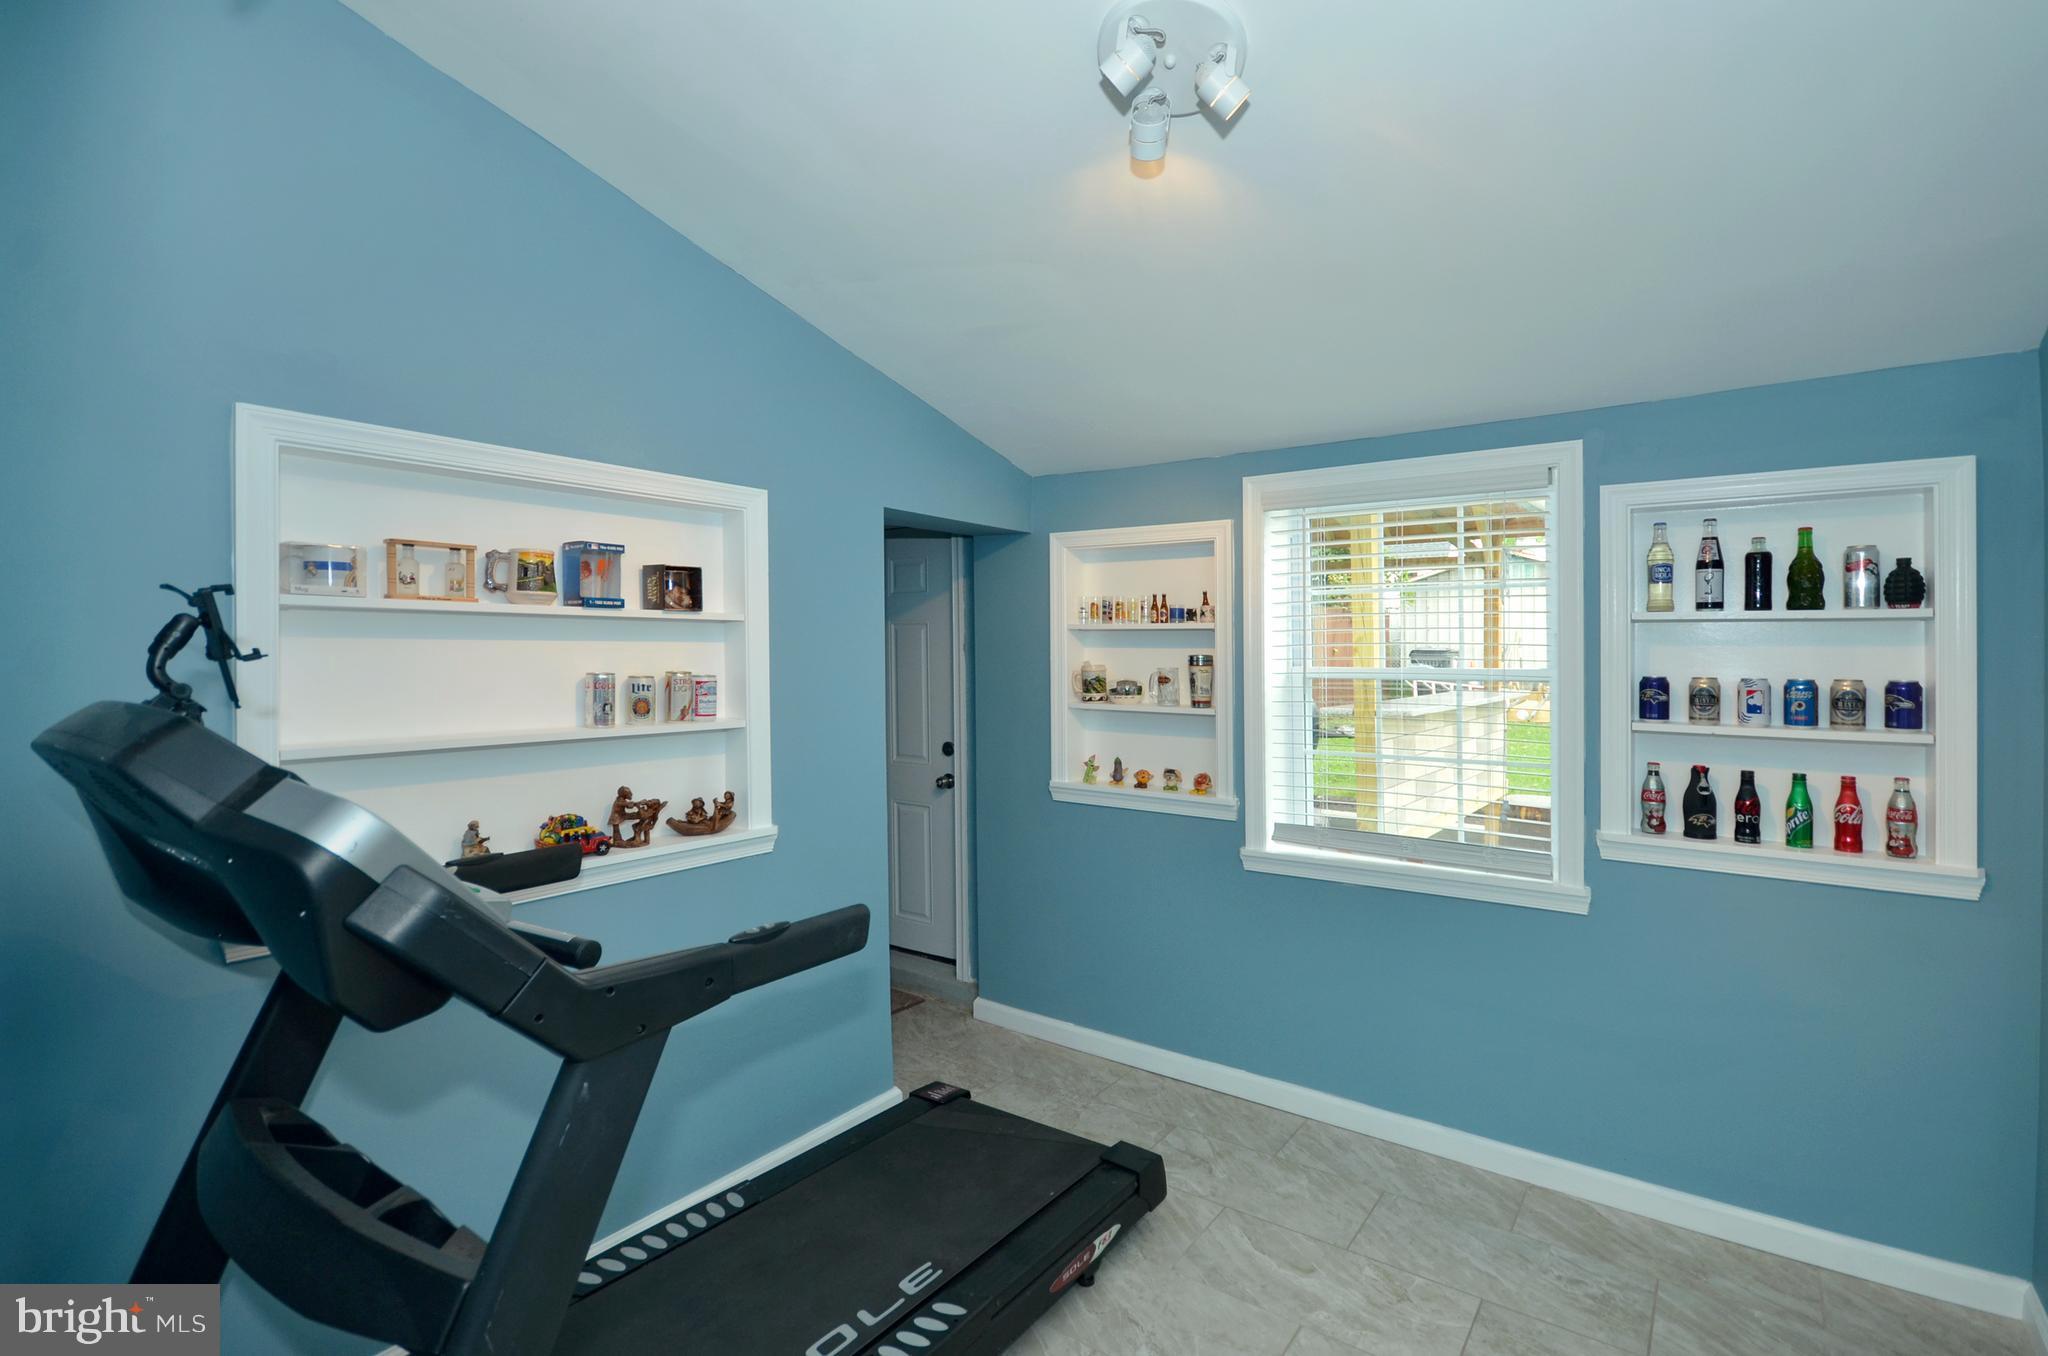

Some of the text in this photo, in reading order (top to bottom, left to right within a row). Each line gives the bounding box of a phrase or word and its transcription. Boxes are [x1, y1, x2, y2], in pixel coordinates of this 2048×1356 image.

[632, 683, 652, 694] Lite
[1735, 814, 1760, 824] ero
[1785, 810, 1809, 834] prite
[1062, 1251, 1091, 1281] SOLE
